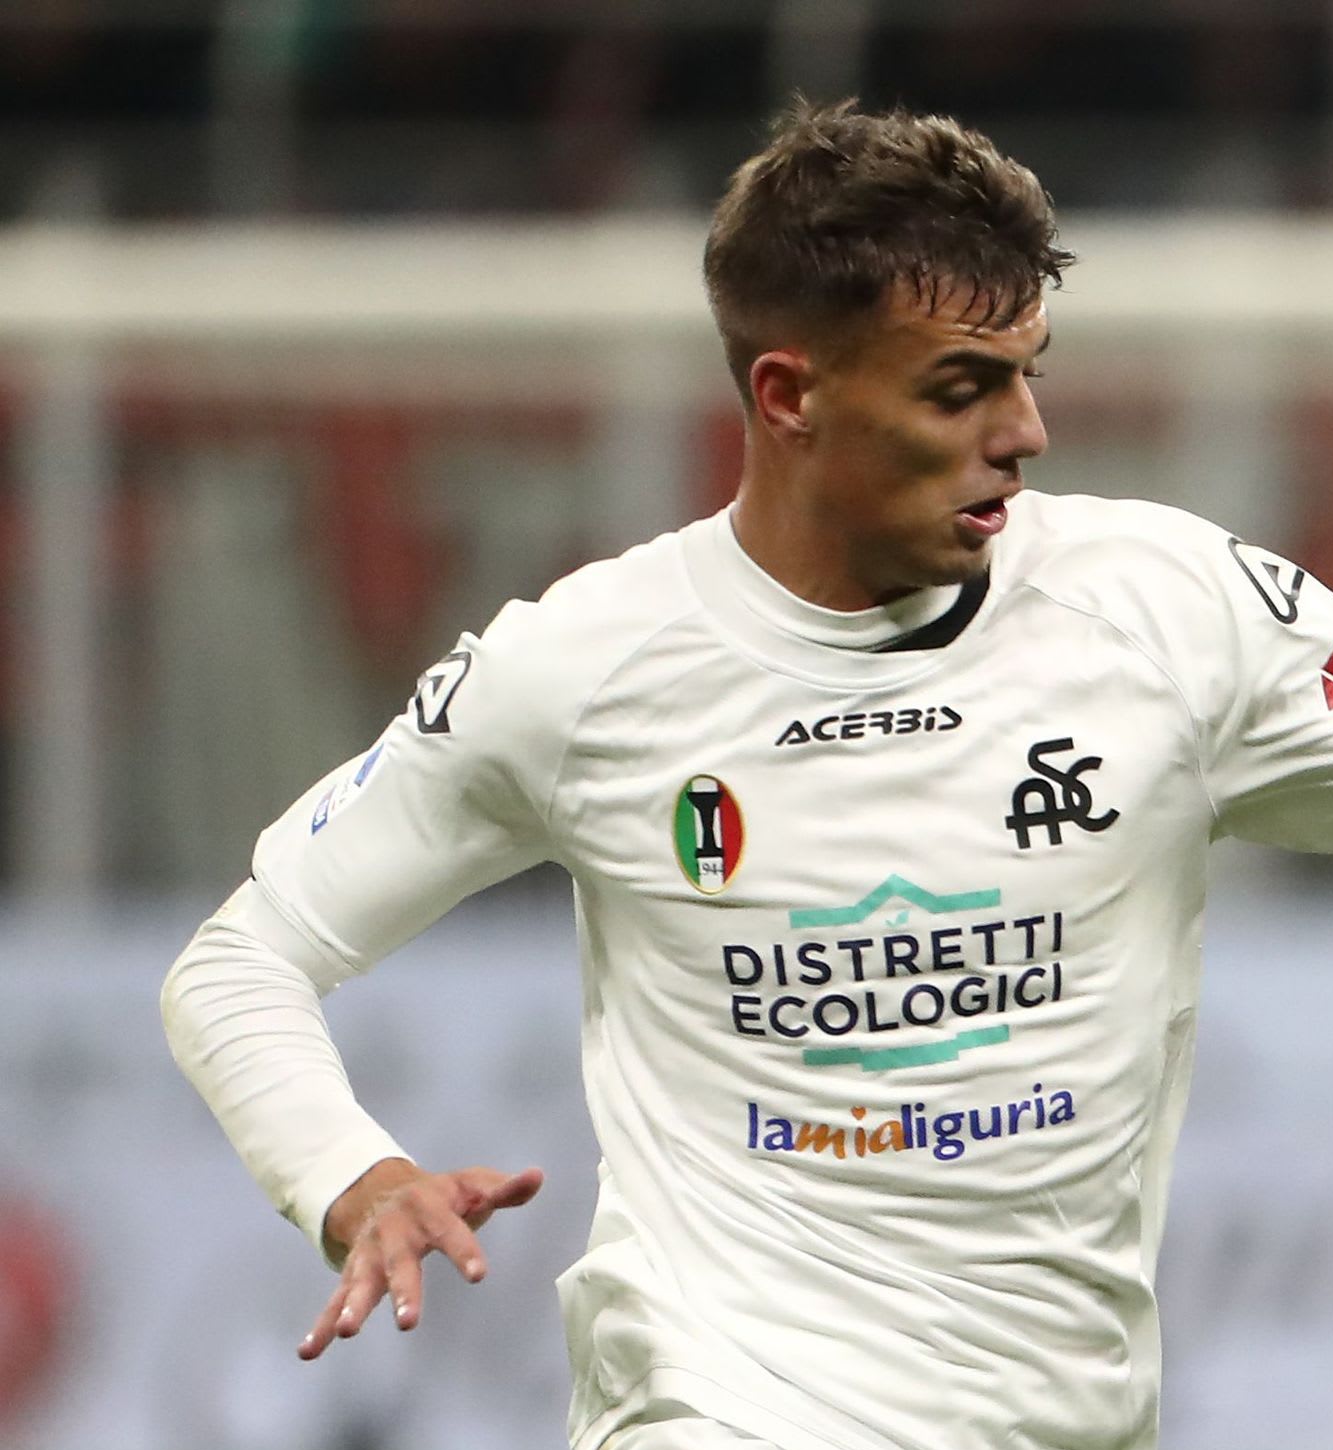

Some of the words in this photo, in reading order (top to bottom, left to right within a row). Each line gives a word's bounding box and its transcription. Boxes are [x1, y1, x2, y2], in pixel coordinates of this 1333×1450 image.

[722, 911, 1064, 986] DISTRETTI
[731, 962, 1063, 1038] ECOLOGICI
[747, 1083, 1076, 1161] lamialiguria
